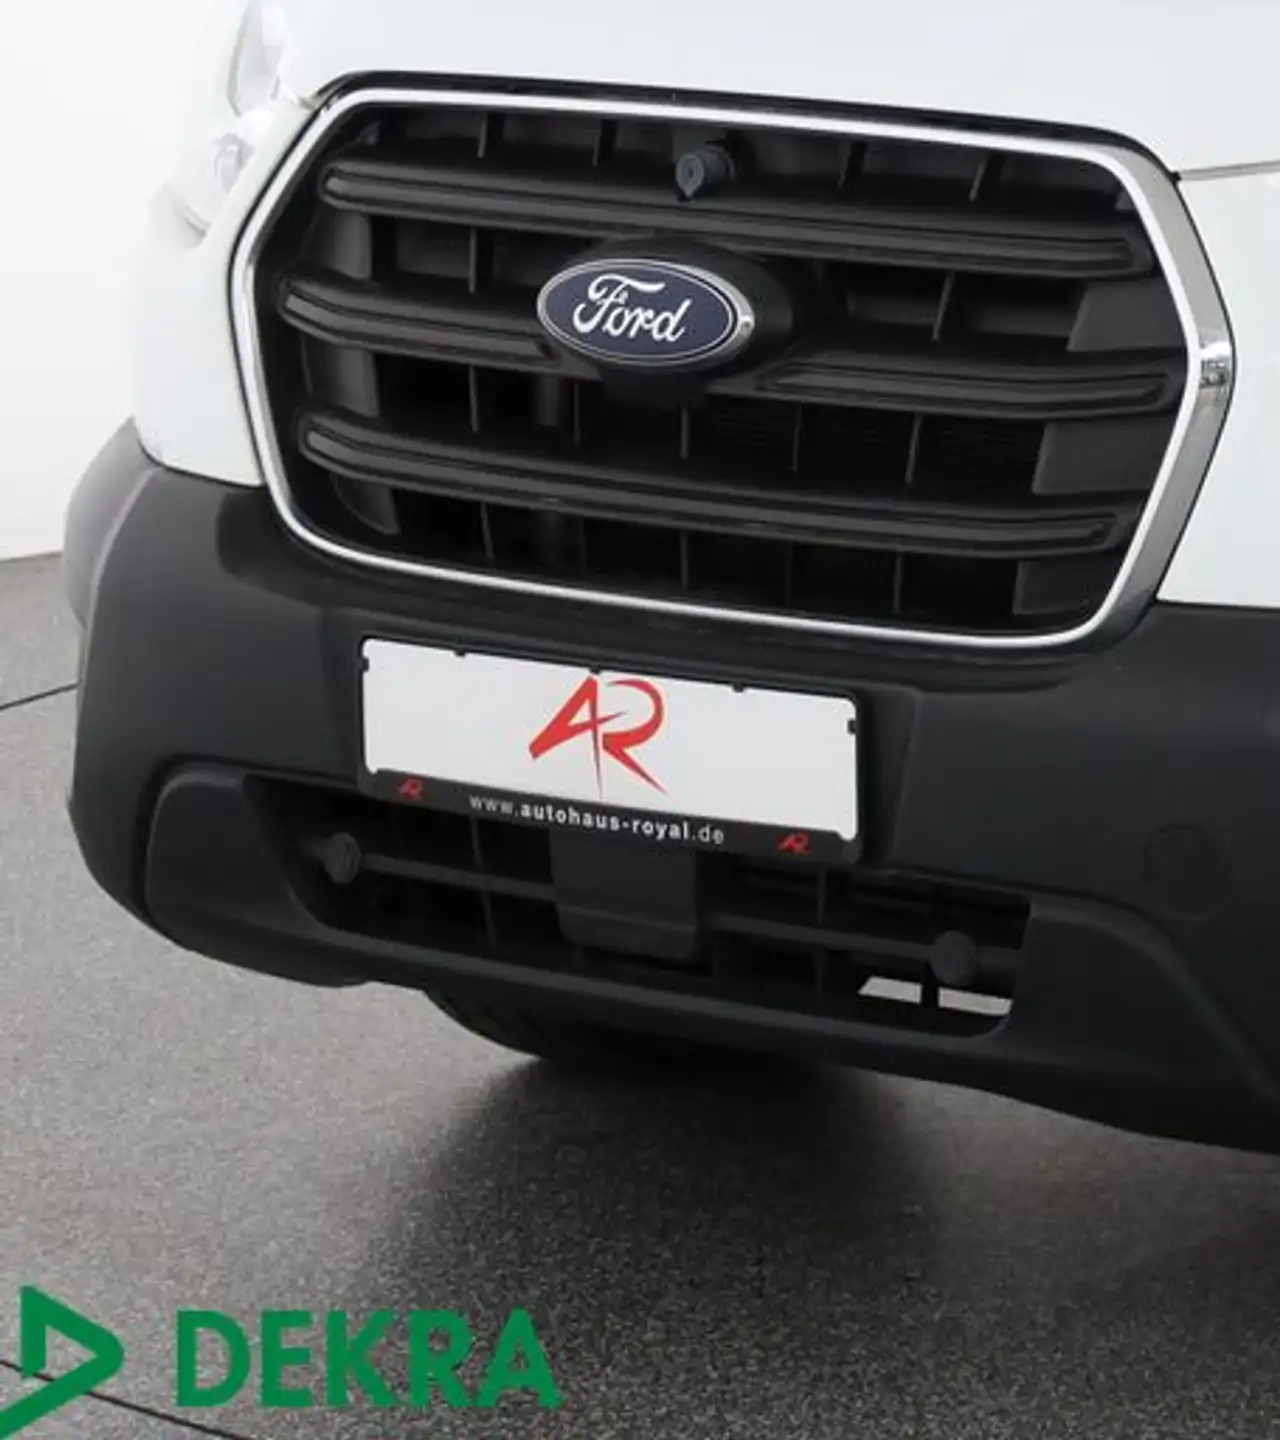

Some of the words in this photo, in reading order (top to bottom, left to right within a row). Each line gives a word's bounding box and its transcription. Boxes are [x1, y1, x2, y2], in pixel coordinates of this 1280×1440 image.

[573, 273, 692, 342] Ford
[529, 675, 669, 797] AR
[469, 795, 725, 845] www.autohaus-royal.de
